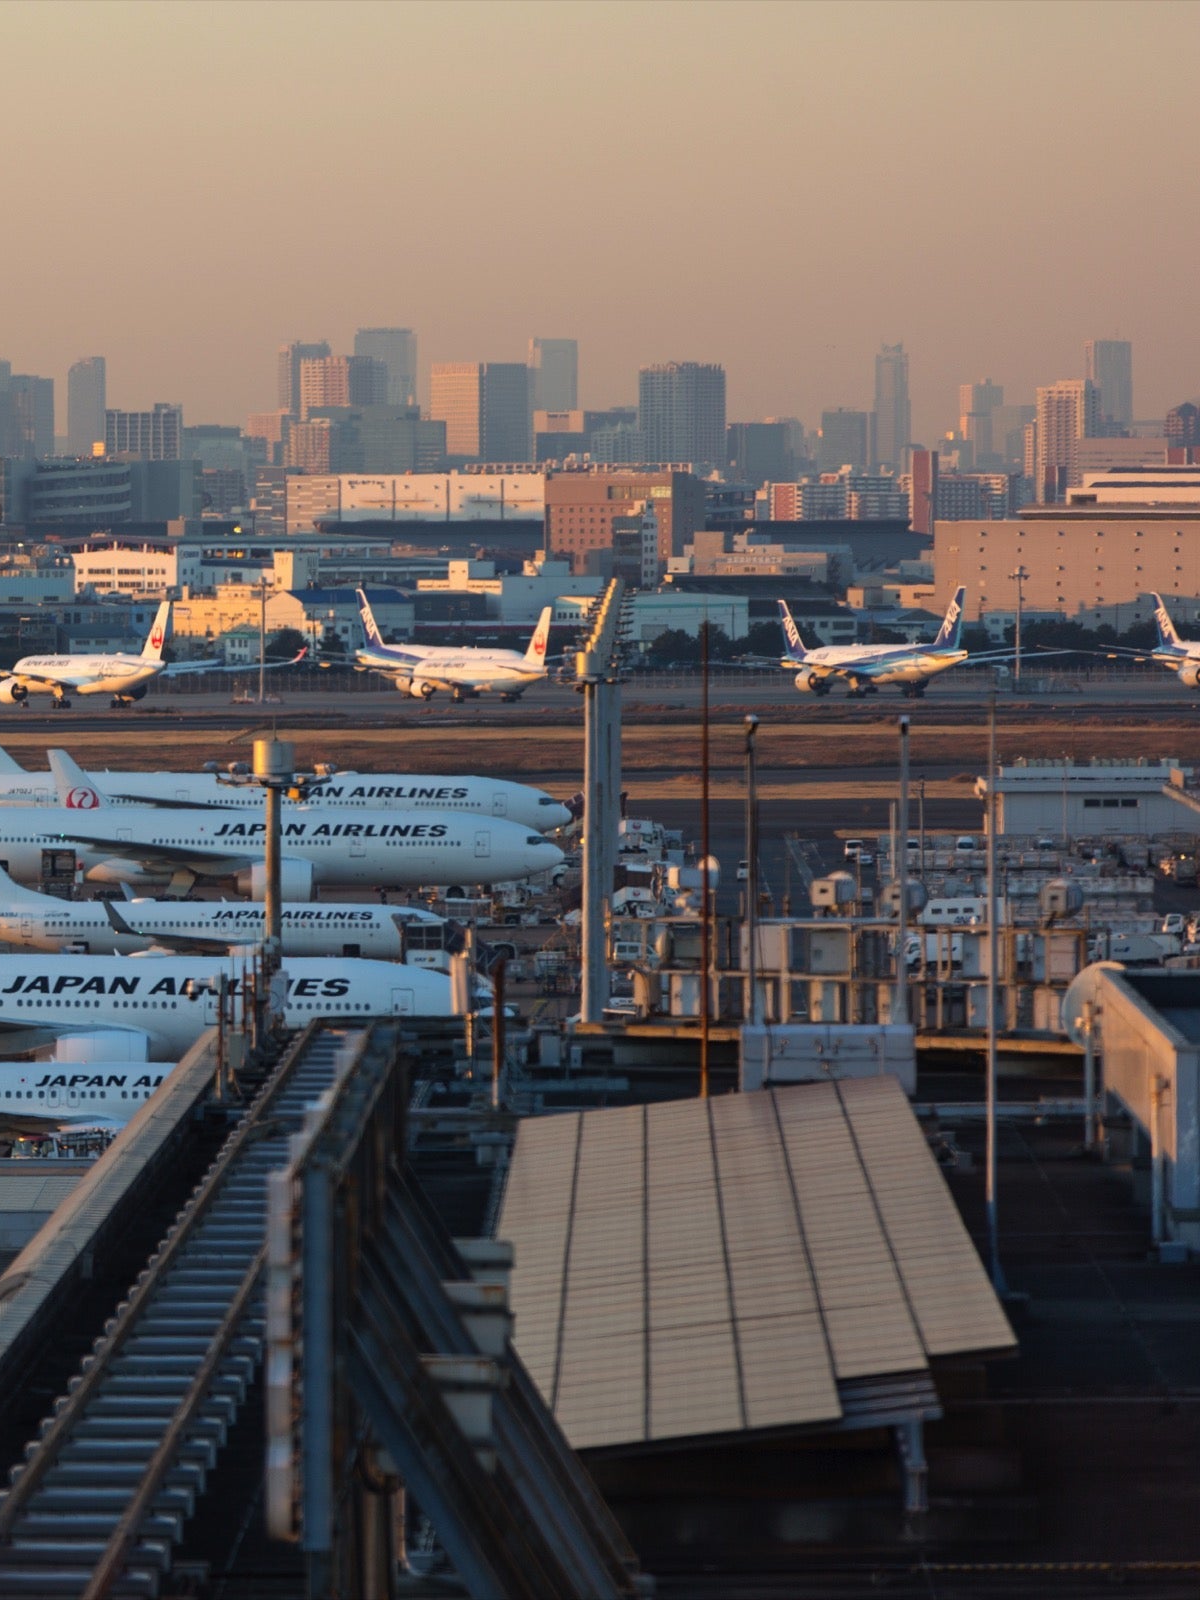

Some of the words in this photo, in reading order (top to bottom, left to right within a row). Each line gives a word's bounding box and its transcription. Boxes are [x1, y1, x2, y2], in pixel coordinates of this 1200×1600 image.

[349, 786, 469, 799] AIRLINES
[213, 824, 307, 836] JAPN
[312, 824, 448, 837] AIRLINES
[211, 910, 267, 920] JAPA
[281, 911, 373, 921] AIRLINES
[1, 976, 141, 995] JAPAN
[35, 1075, 128, 1088] JAPAN
